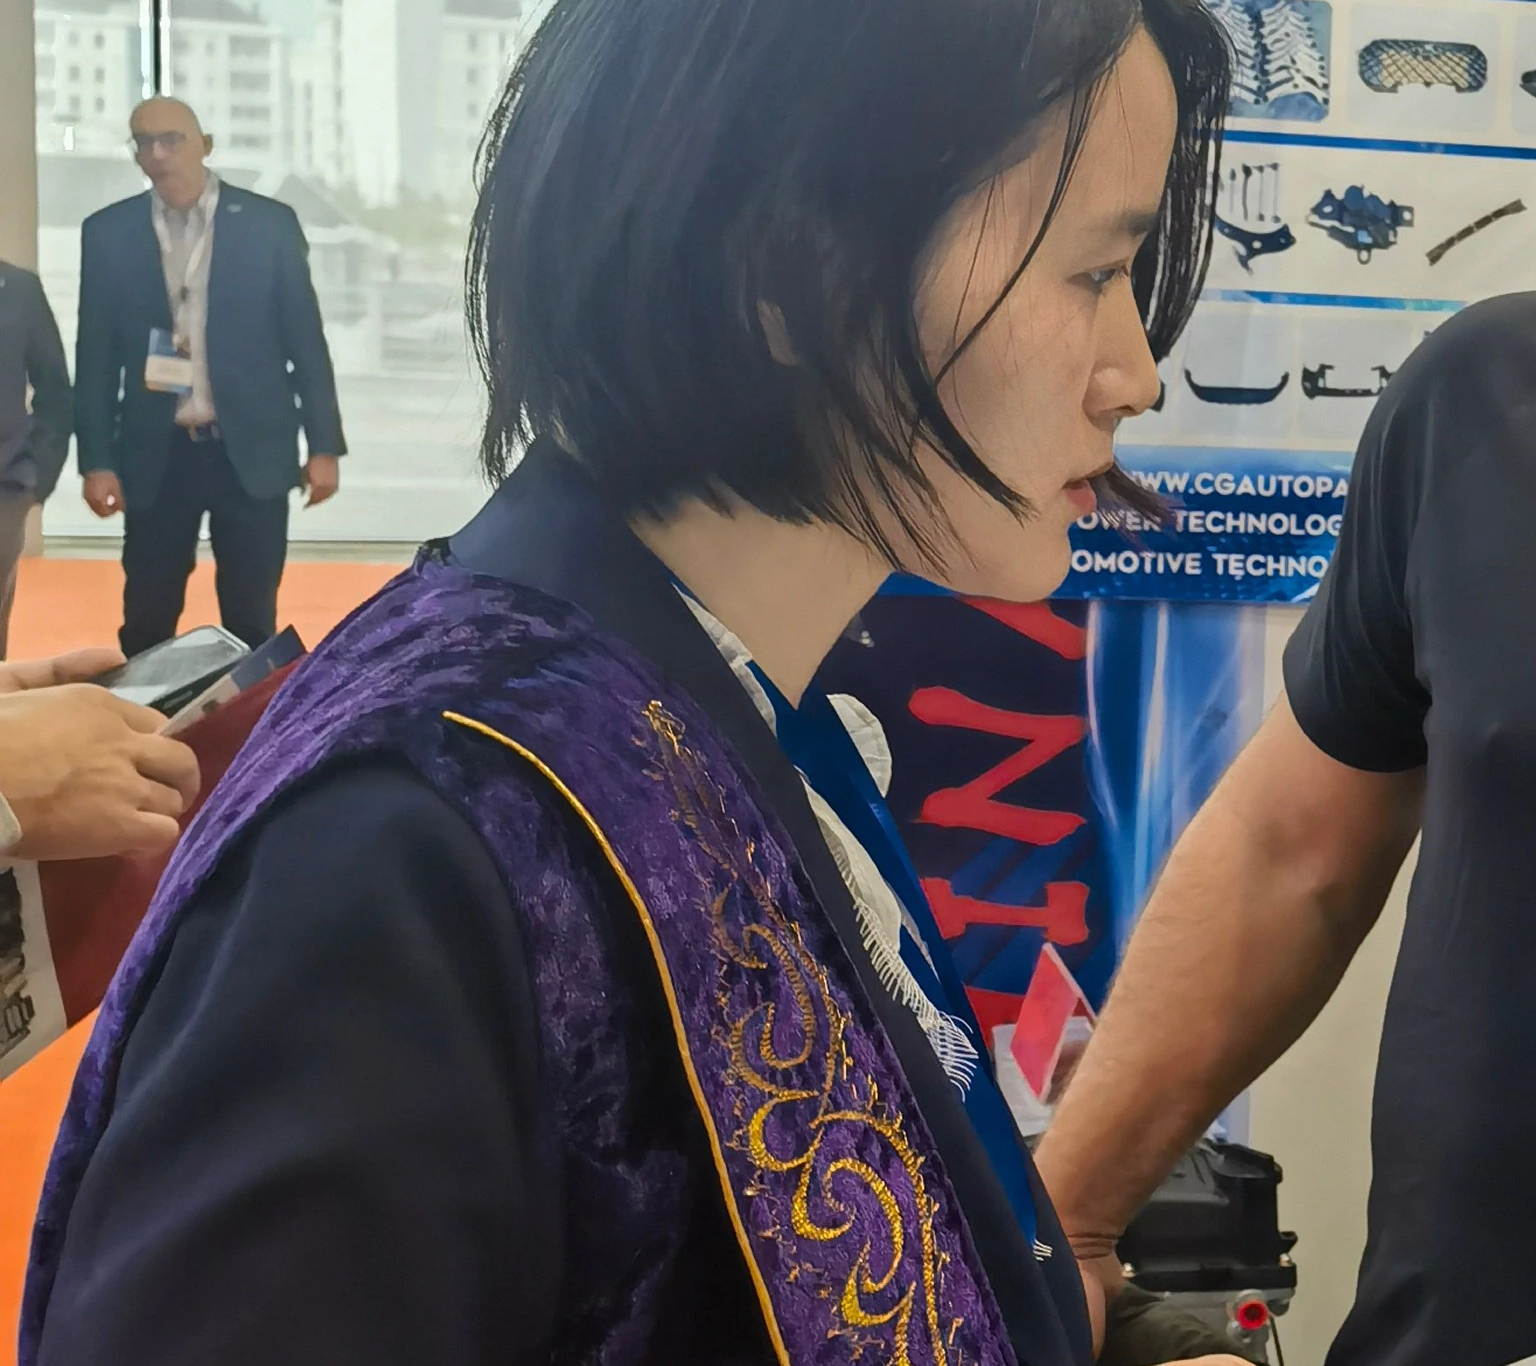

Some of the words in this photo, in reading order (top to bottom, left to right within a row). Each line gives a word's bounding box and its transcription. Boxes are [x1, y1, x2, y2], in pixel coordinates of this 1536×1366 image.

[1131, 470, 1348, 499] WW.CGAUTOPA
[1076, 508, 1163, 533] OWER
[1071, 549, 1202, 575] OMOTIVE
